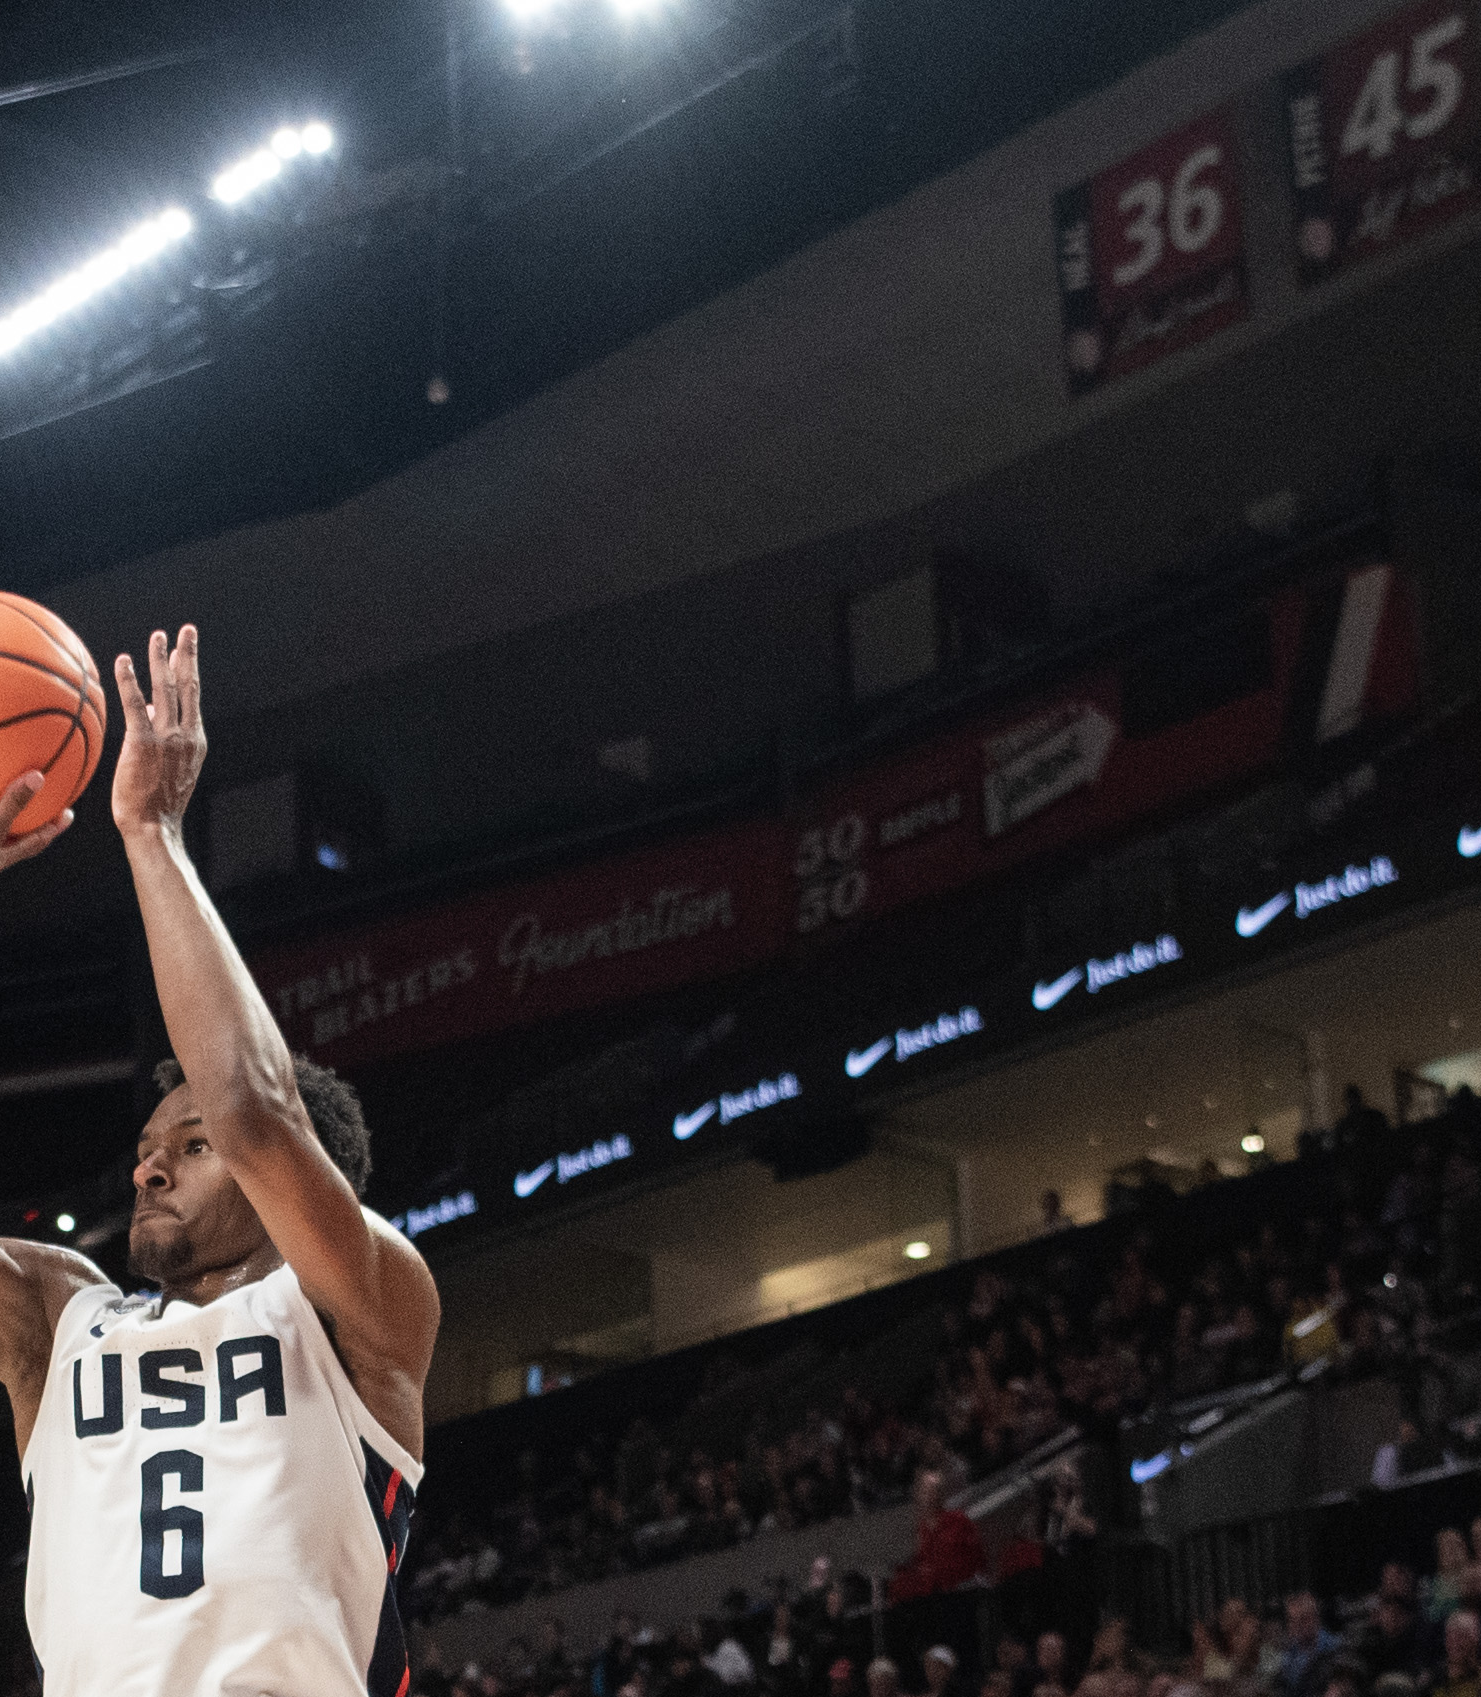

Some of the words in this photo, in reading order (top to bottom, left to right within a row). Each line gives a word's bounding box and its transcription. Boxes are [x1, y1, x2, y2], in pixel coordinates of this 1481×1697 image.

[1340, 14, 1466, 160] 45
[1112, 144, 1225, 287] 36
[1295, 876, 1339, 918] Just
[1339, 865, 1370, 900] do
[275, 953, 375, 1019] TRAIL
[313, 947, 478, 1045] BLAZERS
[73, 1334, 287, 1440] USA
[140, 1449, 205, 1600] 6
